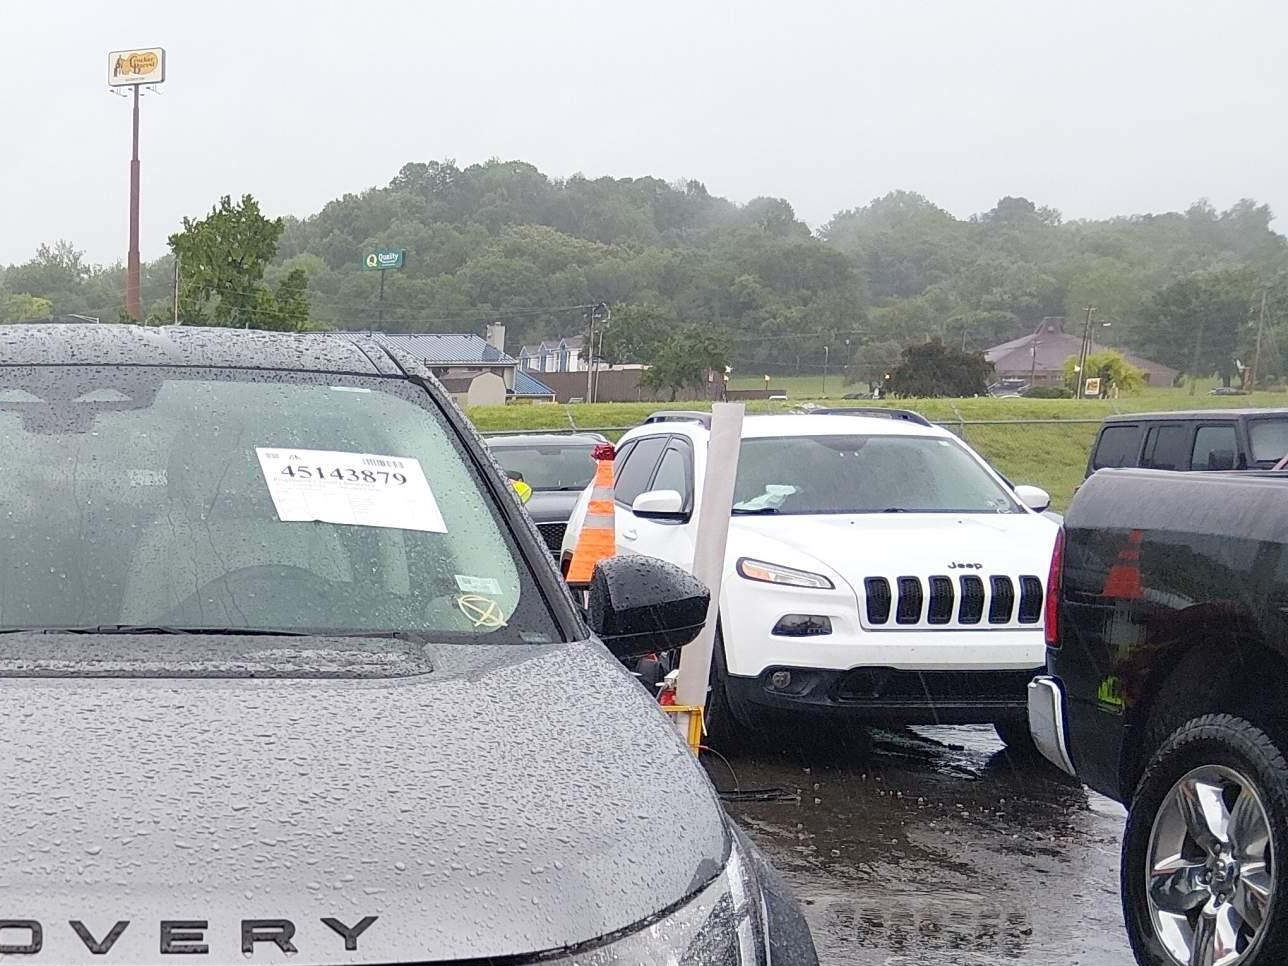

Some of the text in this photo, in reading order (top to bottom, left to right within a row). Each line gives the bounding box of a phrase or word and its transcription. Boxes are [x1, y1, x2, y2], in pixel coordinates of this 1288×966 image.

[378, 252, 399, 263] Quality
[280, 464, 408, 486] 45143879
[947, 561, 983, 570] Jeep
